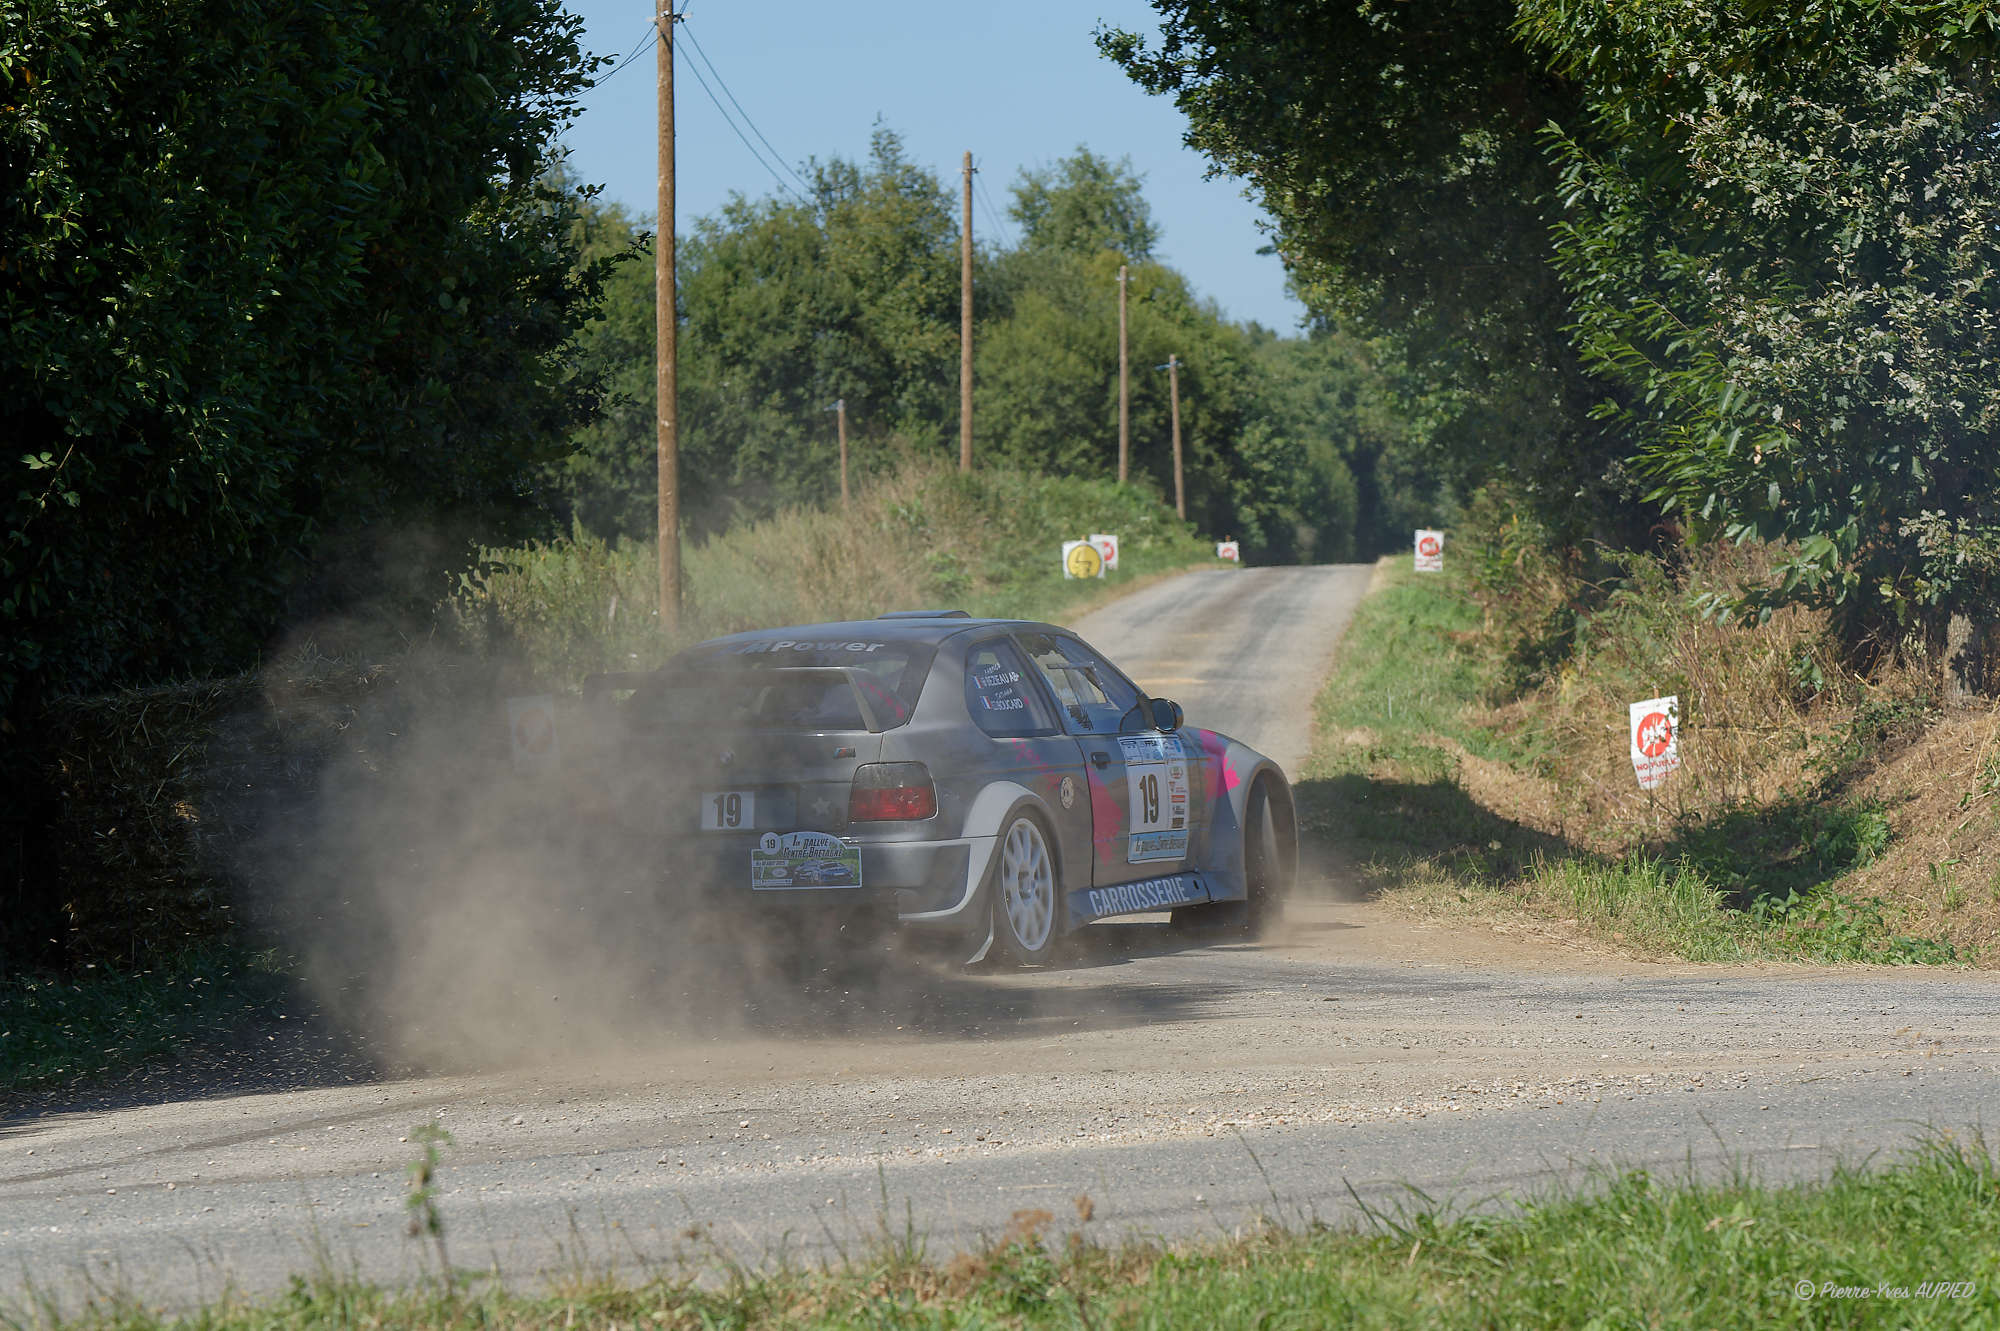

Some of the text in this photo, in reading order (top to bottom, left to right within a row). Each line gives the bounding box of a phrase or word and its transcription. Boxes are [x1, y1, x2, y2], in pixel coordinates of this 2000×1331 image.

[713, 793, 742, 827] 19
[1139, 773, 1159, 824] 19
[766, 838, 776, 849] 19
[803, 838, 829, 849] RALLYE
[1088, 876, 1190, 916] CARROSSERIE
